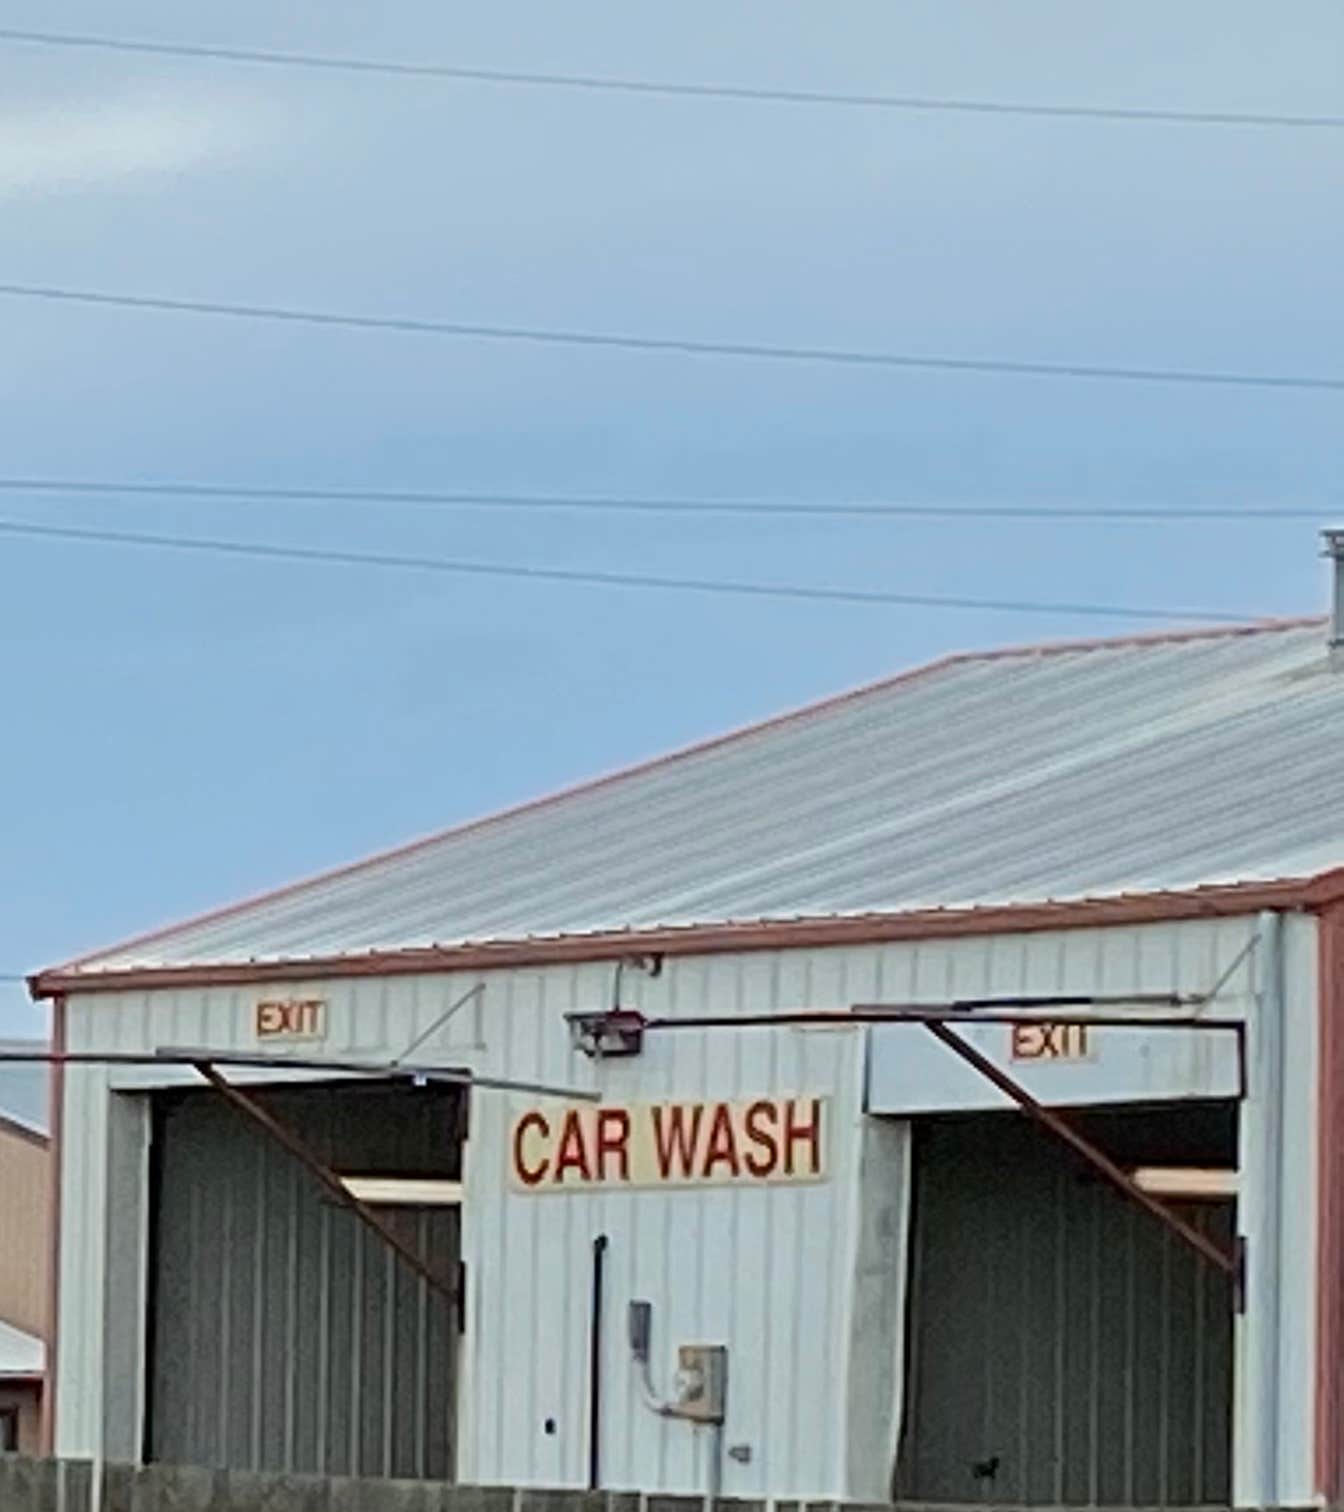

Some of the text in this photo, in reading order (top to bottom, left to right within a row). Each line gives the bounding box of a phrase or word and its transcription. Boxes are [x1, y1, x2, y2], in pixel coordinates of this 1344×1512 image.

[257, 1000, 326, 1036] EXIT
[512, 1098, 820, 1185] CAR WASH
